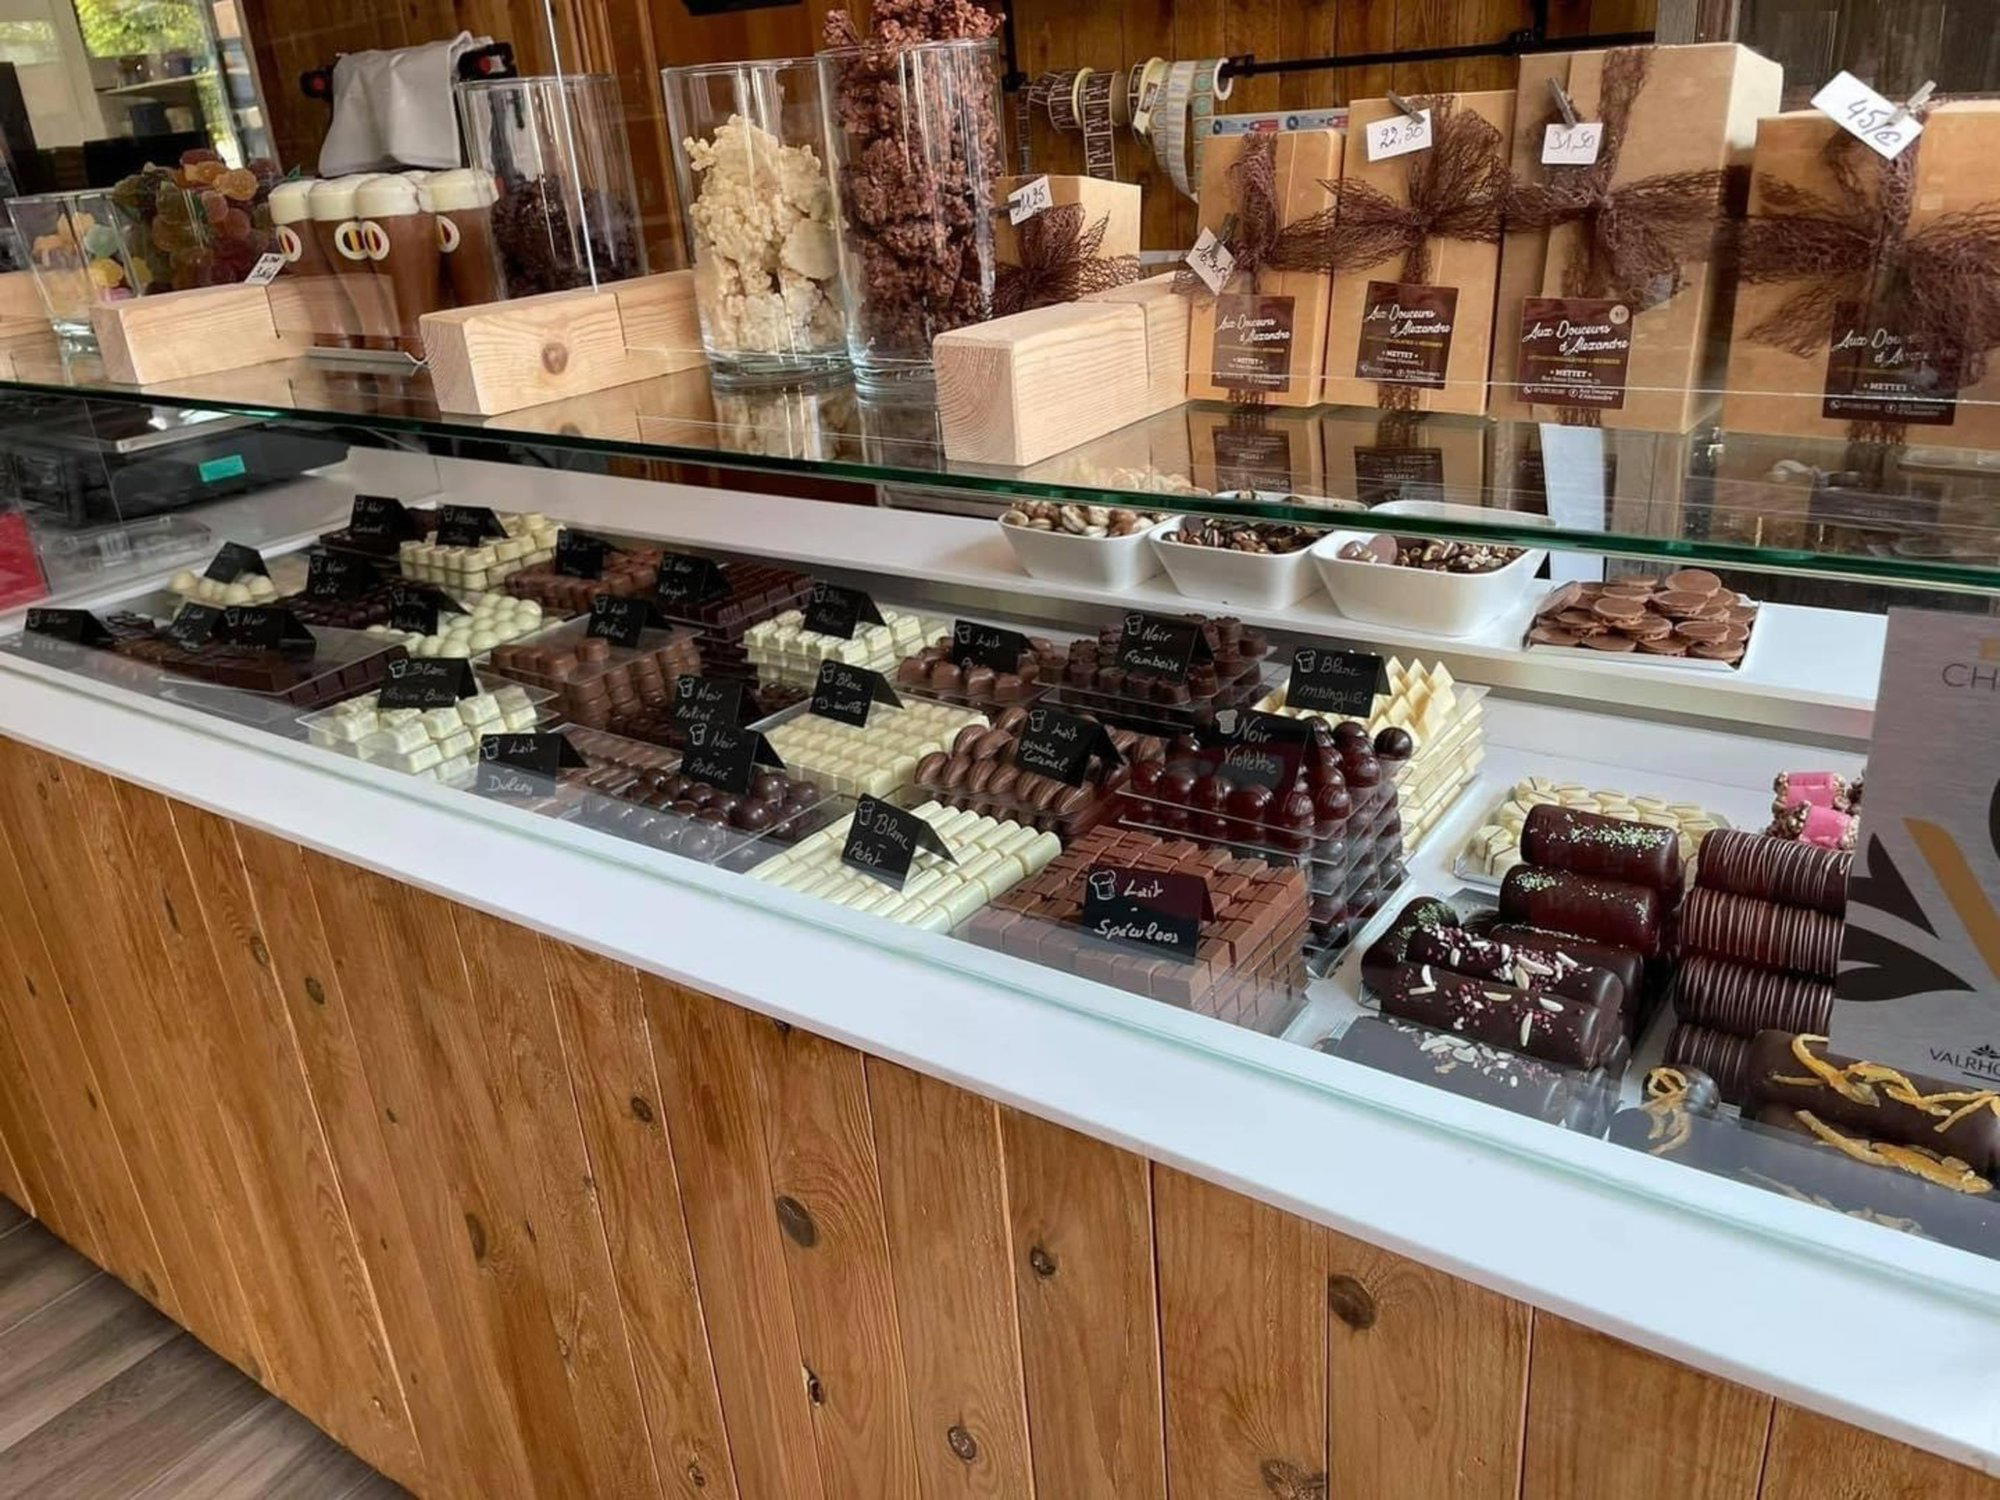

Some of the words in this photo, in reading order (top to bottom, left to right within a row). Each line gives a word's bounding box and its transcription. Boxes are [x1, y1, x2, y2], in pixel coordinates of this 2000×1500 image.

[1389, 303, 1437, 321] Douceurs
[1522, 321, 1554, 342] Aux
[1555, 320, 1612, 339] Douceurs
[1831, 329, 1868, 352] Aux
[1559, 335, 1630, 356] d'Alexandre
[1142, 624, 1172, 642] Noir
[710, 730, 738, 749] Noir
[1231, 715, 1273, 743] Noir
[1123, 878, 1164, 898] Lait
[1093, 918, 1179, 944] Spéculoos
